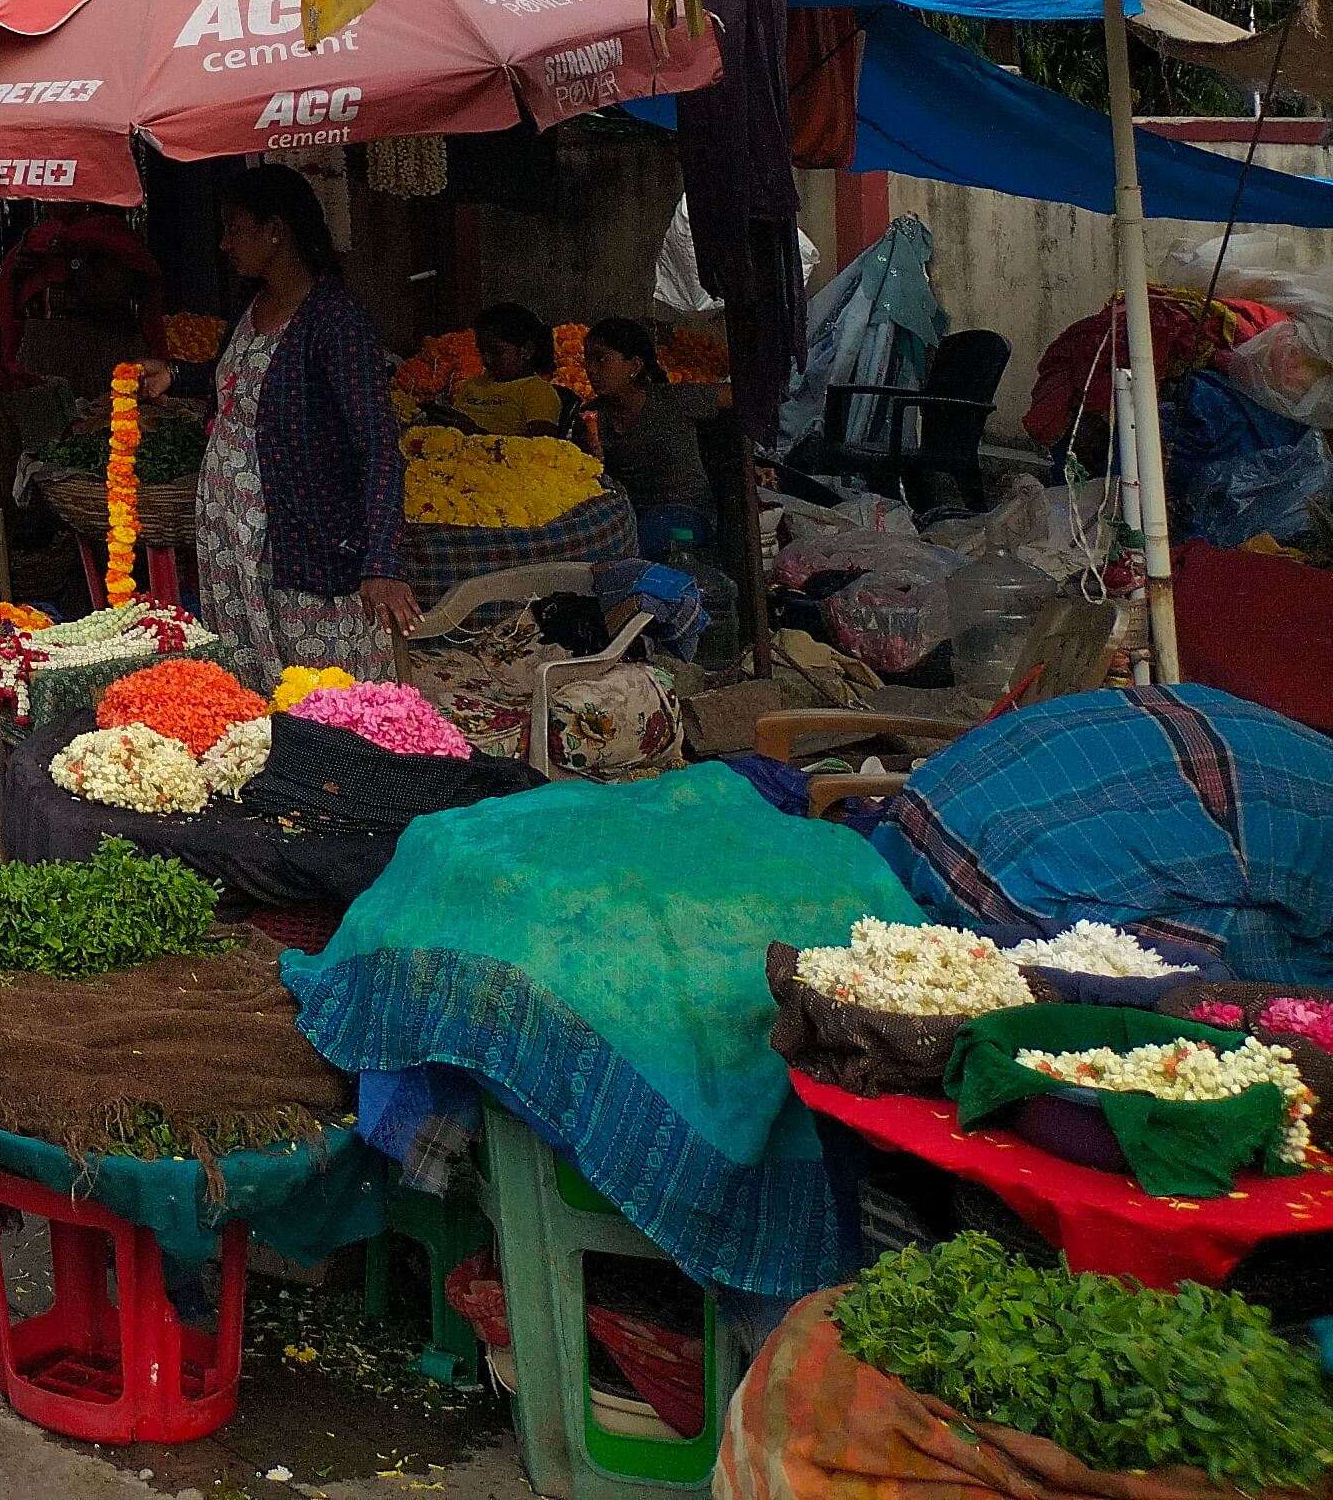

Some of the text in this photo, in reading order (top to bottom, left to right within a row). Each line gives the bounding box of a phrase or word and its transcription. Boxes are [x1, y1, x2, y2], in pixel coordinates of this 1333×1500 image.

[203, 29, 359, 72] cement
[254, 86, 362, 130] ACC
[268, 126, 351, 149] cement
